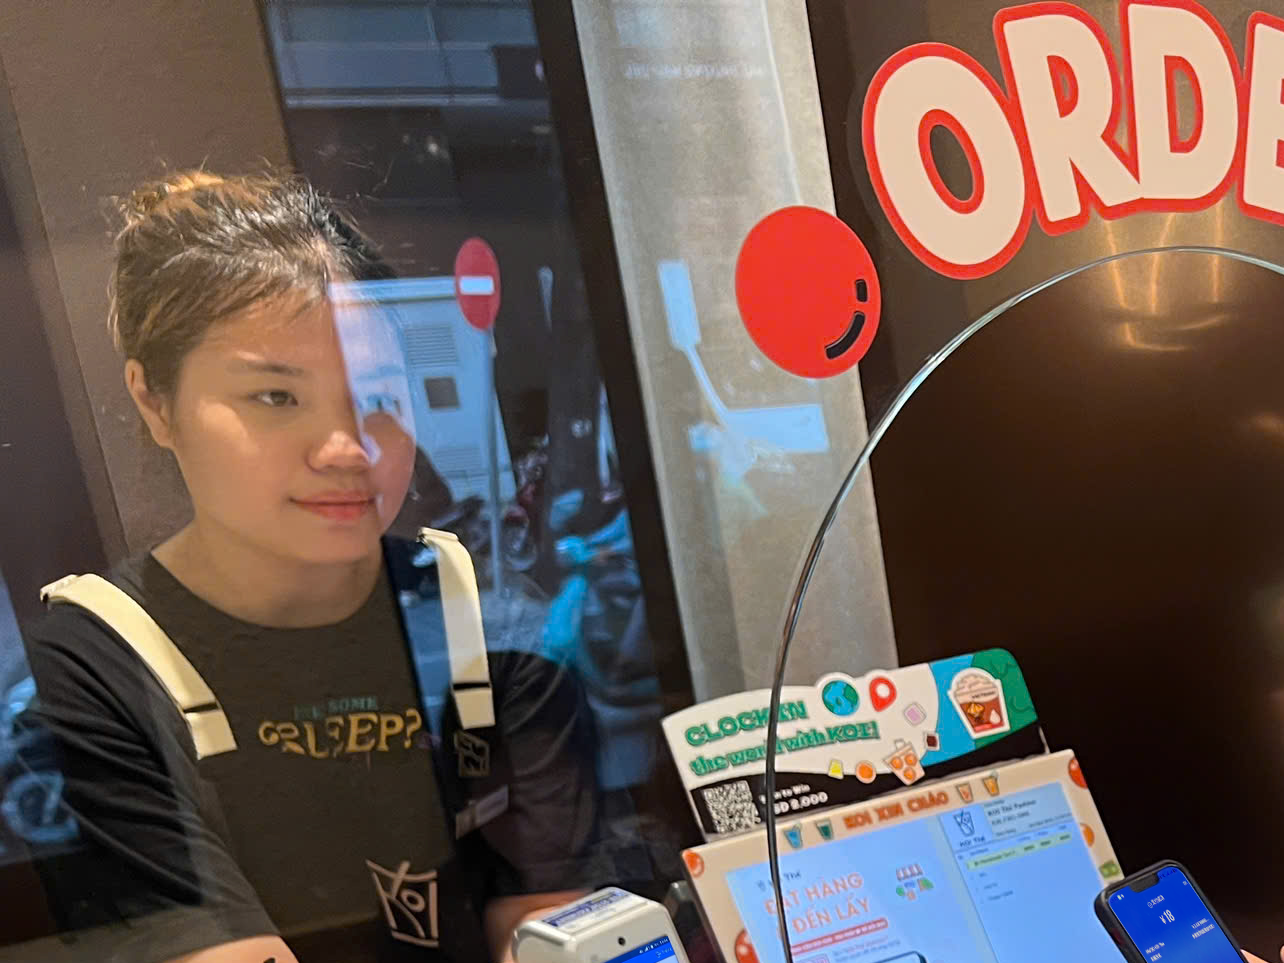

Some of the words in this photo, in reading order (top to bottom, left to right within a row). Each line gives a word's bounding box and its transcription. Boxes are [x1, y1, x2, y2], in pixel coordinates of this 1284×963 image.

[689, 754, 729, 777] the
[727, 738, 785, 768] word
[784, 727, 826, 752] with
[843, 807, 873, 830] KOI
[874, 800, 905, 823] XIN
[804, 872, 864, 903] HÀNG
